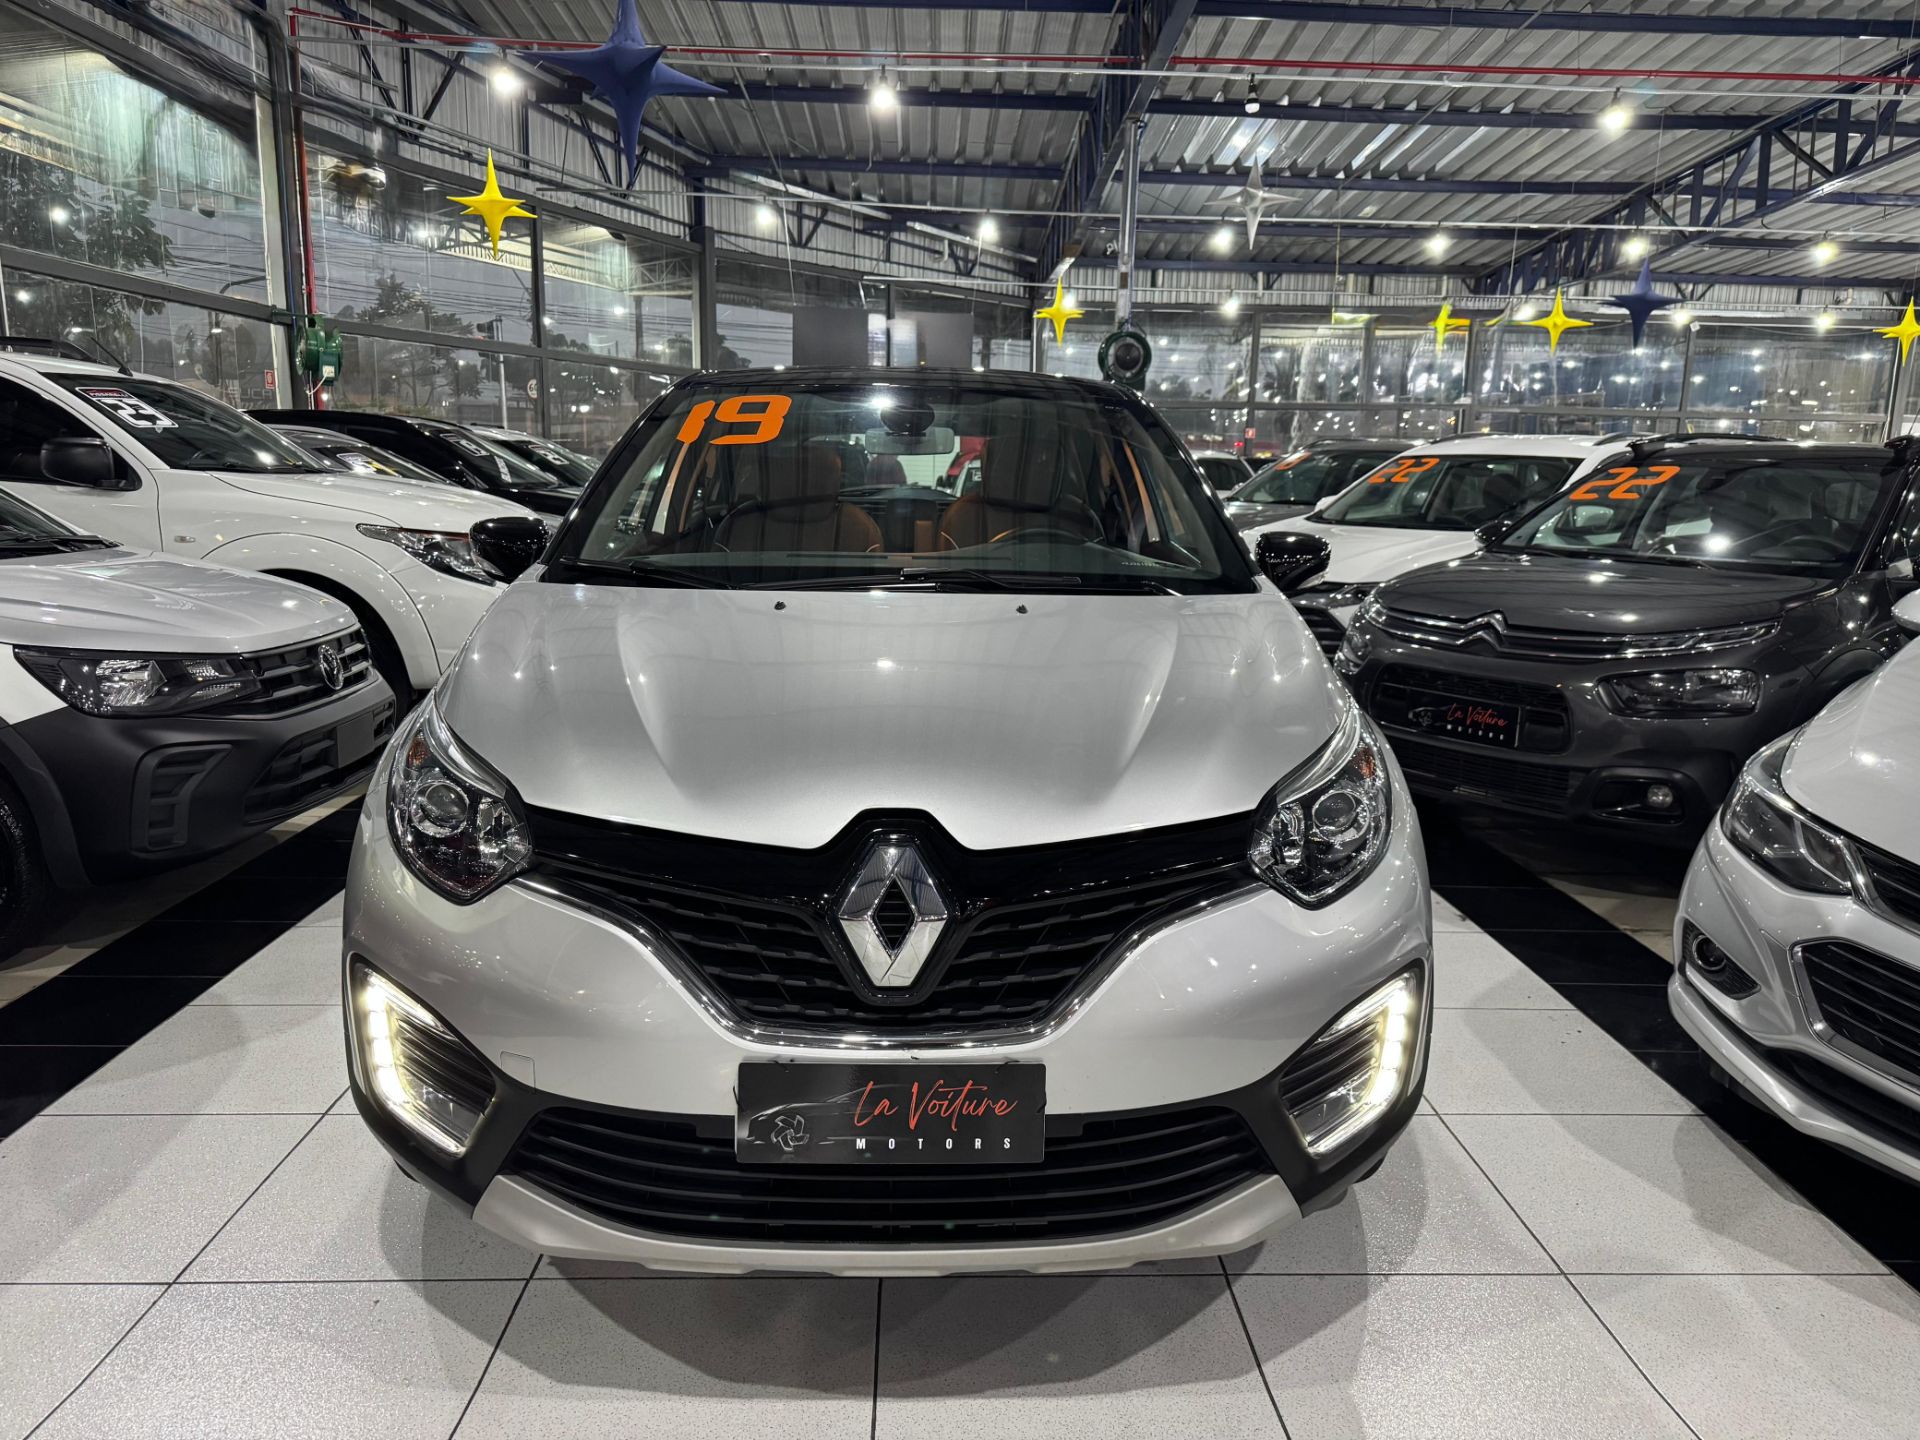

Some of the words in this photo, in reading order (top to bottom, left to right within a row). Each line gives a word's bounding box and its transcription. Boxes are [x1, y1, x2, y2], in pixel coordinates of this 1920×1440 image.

[100, 398, 173, 426] 23
[675, 394, 793, 445] 19
[1366, 458, 1440, 484] 22
[1568, 465, 1681, 499] 22
[854, 1081, 898, 1127] La
[908, 1080, 1018, 1132] Voiture
[855, 1138, 1011, 1150] MOTORS
